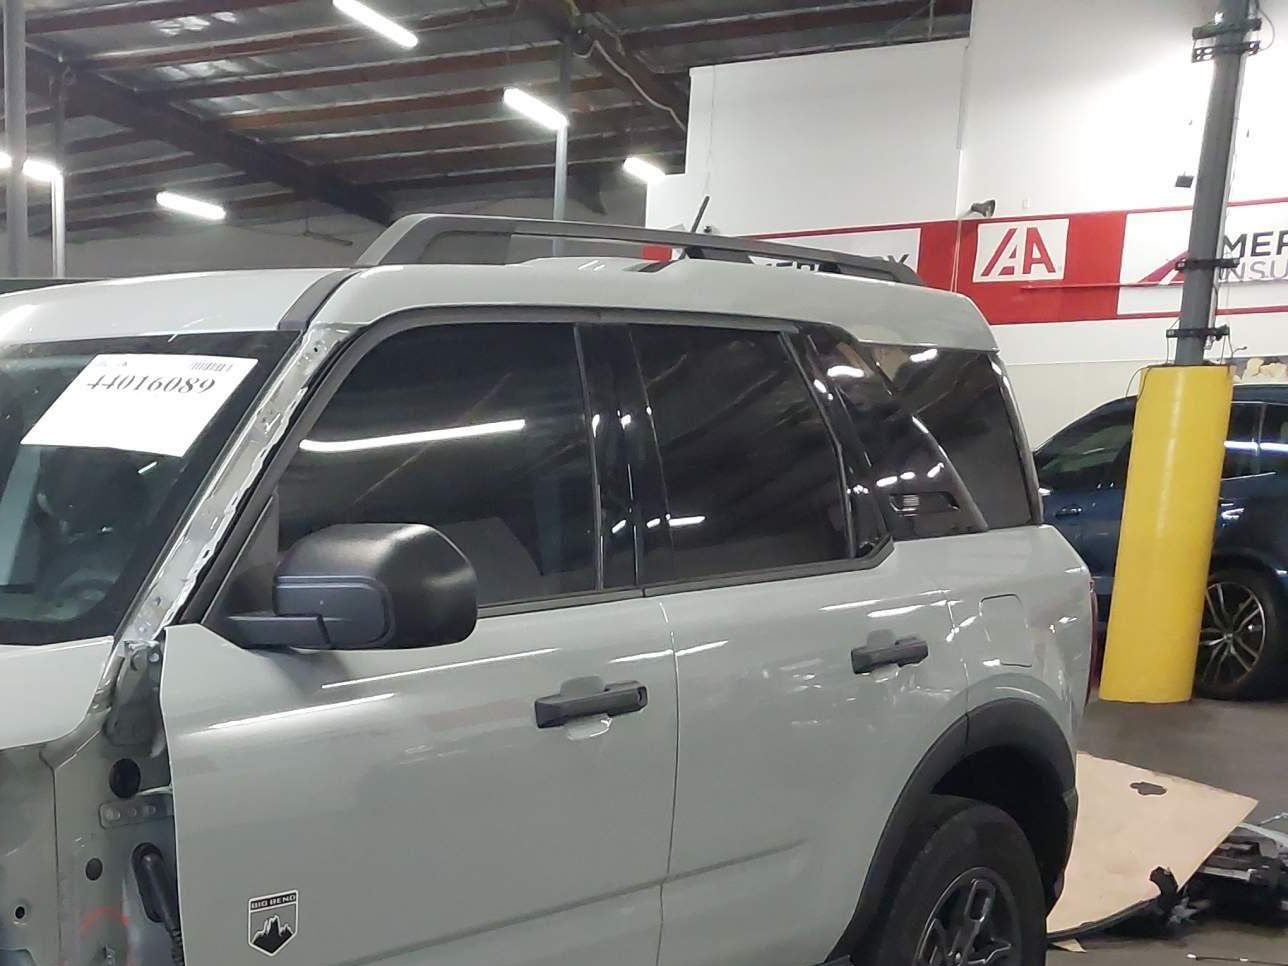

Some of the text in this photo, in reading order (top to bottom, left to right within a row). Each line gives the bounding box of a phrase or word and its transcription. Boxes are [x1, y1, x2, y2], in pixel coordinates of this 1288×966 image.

[86, 373, 217, 394] 44016089
[251, 894, 296, 909] BIG BEND
